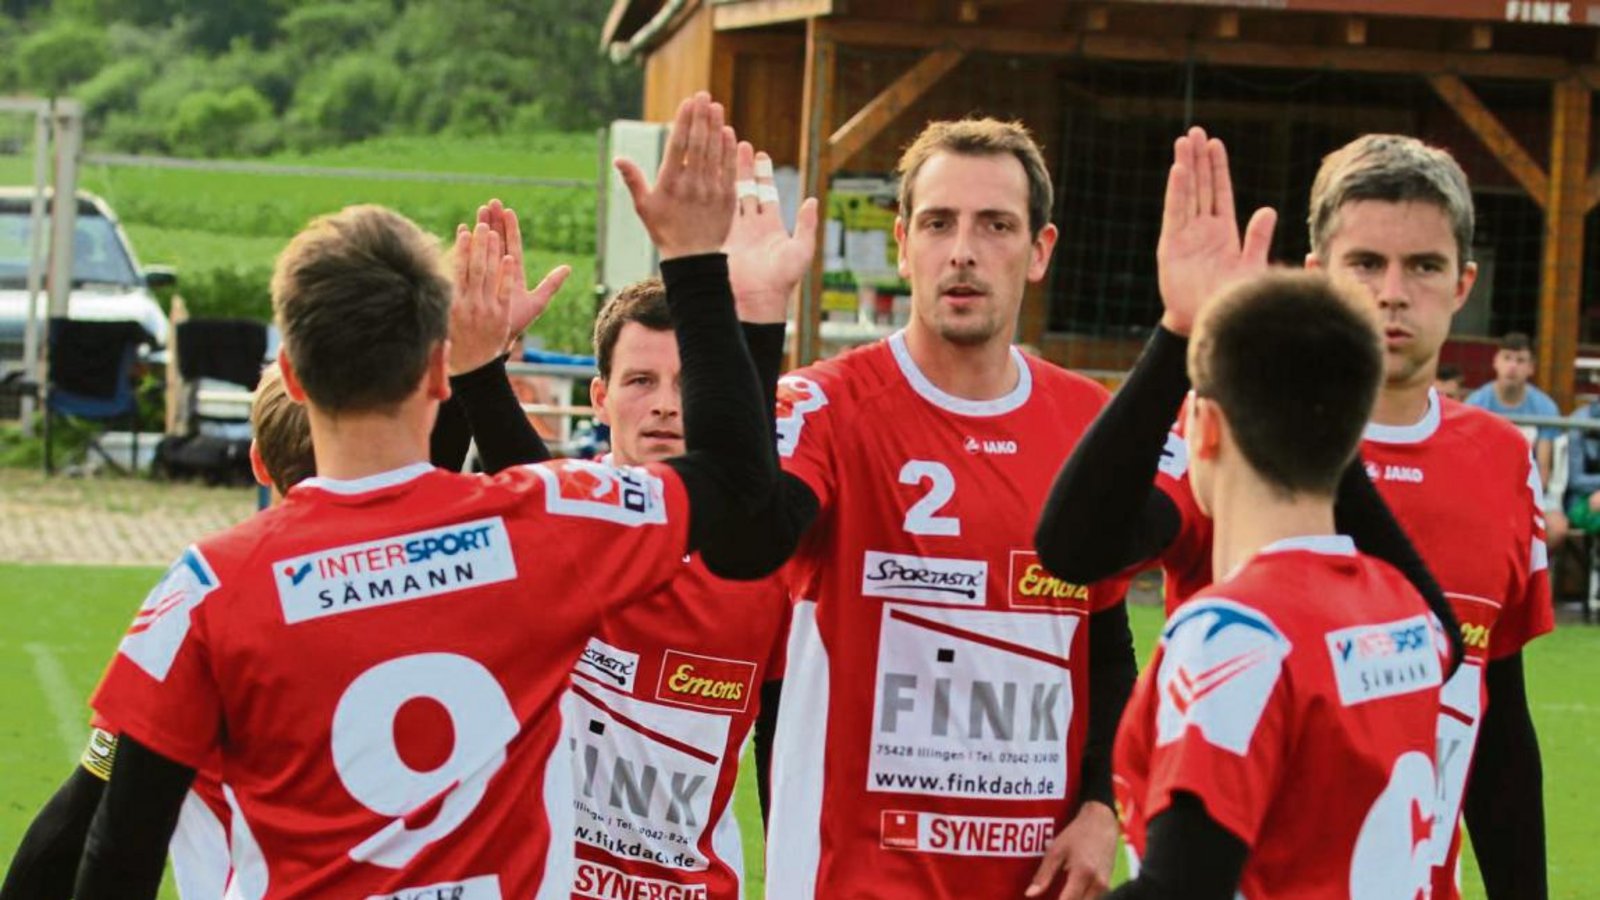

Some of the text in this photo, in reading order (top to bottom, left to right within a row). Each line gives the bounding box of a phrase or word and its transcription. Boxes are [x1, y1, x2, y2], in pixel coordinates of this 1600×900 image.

[1505, 0, 1570, 24] FINK
[982, 440, 1017, 453] JAKO
[1384, 464, 1424, 483] JAKO
[898, 459, 960, 536] 2
[318, 526, 493, 580] INTERSPORT
[318, 562, 474, 609] SÄMANN
[668, 664, 744, 700] Emons
[880, 673, 1062, 741] FINK
[331, 652, 520, 868] 9
[570, 737, 706, 827] INK
[875, 773, 1054, 795] www.finkdach.de
[929, 818, 1053, 853] SYNERGIE
